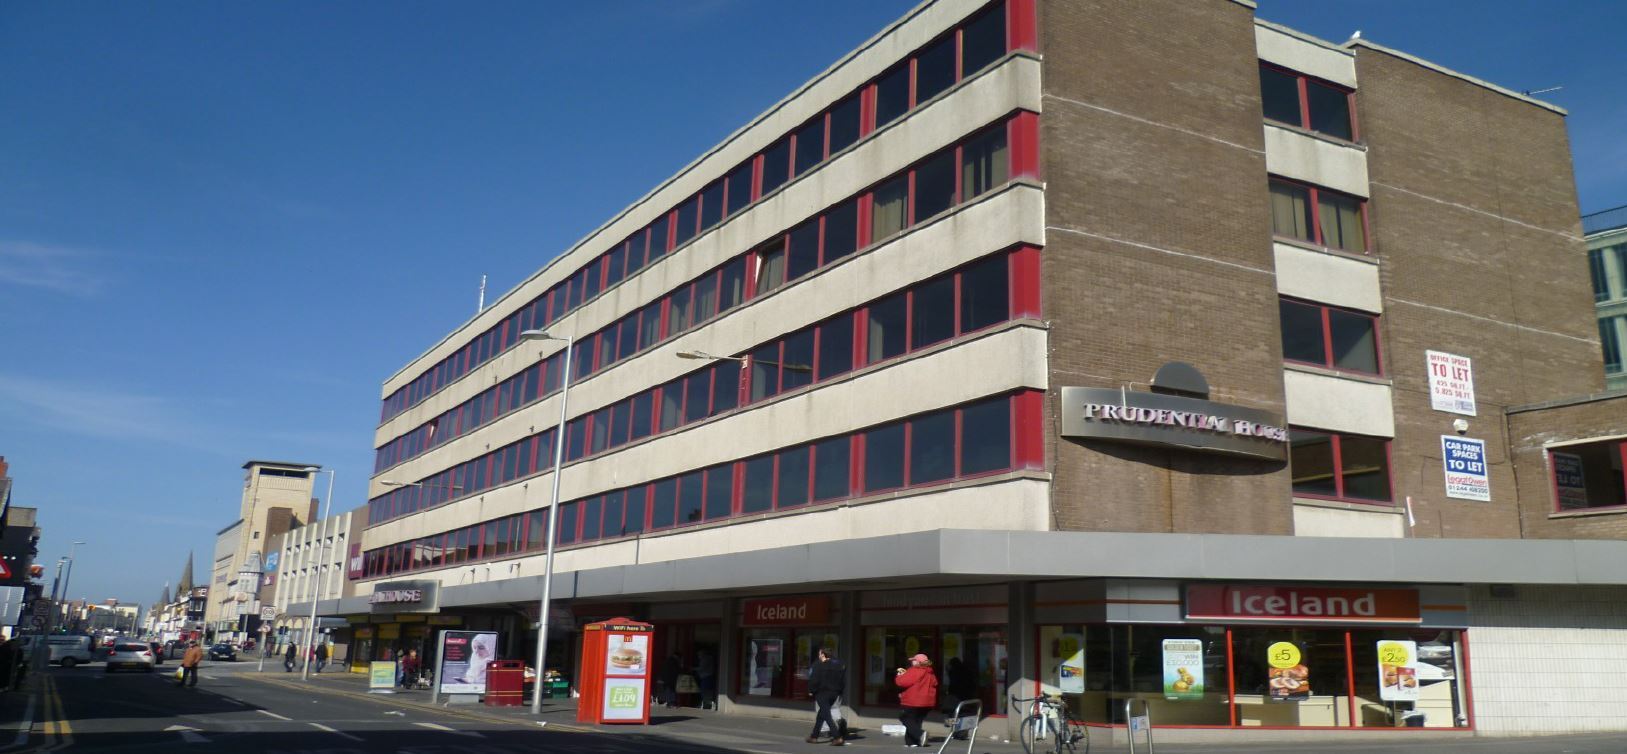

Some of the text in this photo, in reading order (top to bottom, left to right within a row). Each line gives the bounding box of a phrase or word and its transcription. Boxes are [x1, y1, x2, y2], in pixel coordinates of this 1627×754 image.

[1431, 363, 1469, 382] TO LET
[1084, 404, 1230, 433] PRUDENTIAL
[1446, 441, 1480, 453] CAR PARK
[1452, 449, 1478, 460] SPACES
[1448, 459, 1482, 472] TO LET
[1232, 591, 1376, 616] Iceland
[755, 603, 807, 620] Iceland
[1275, 649, 1291, 661] £5
